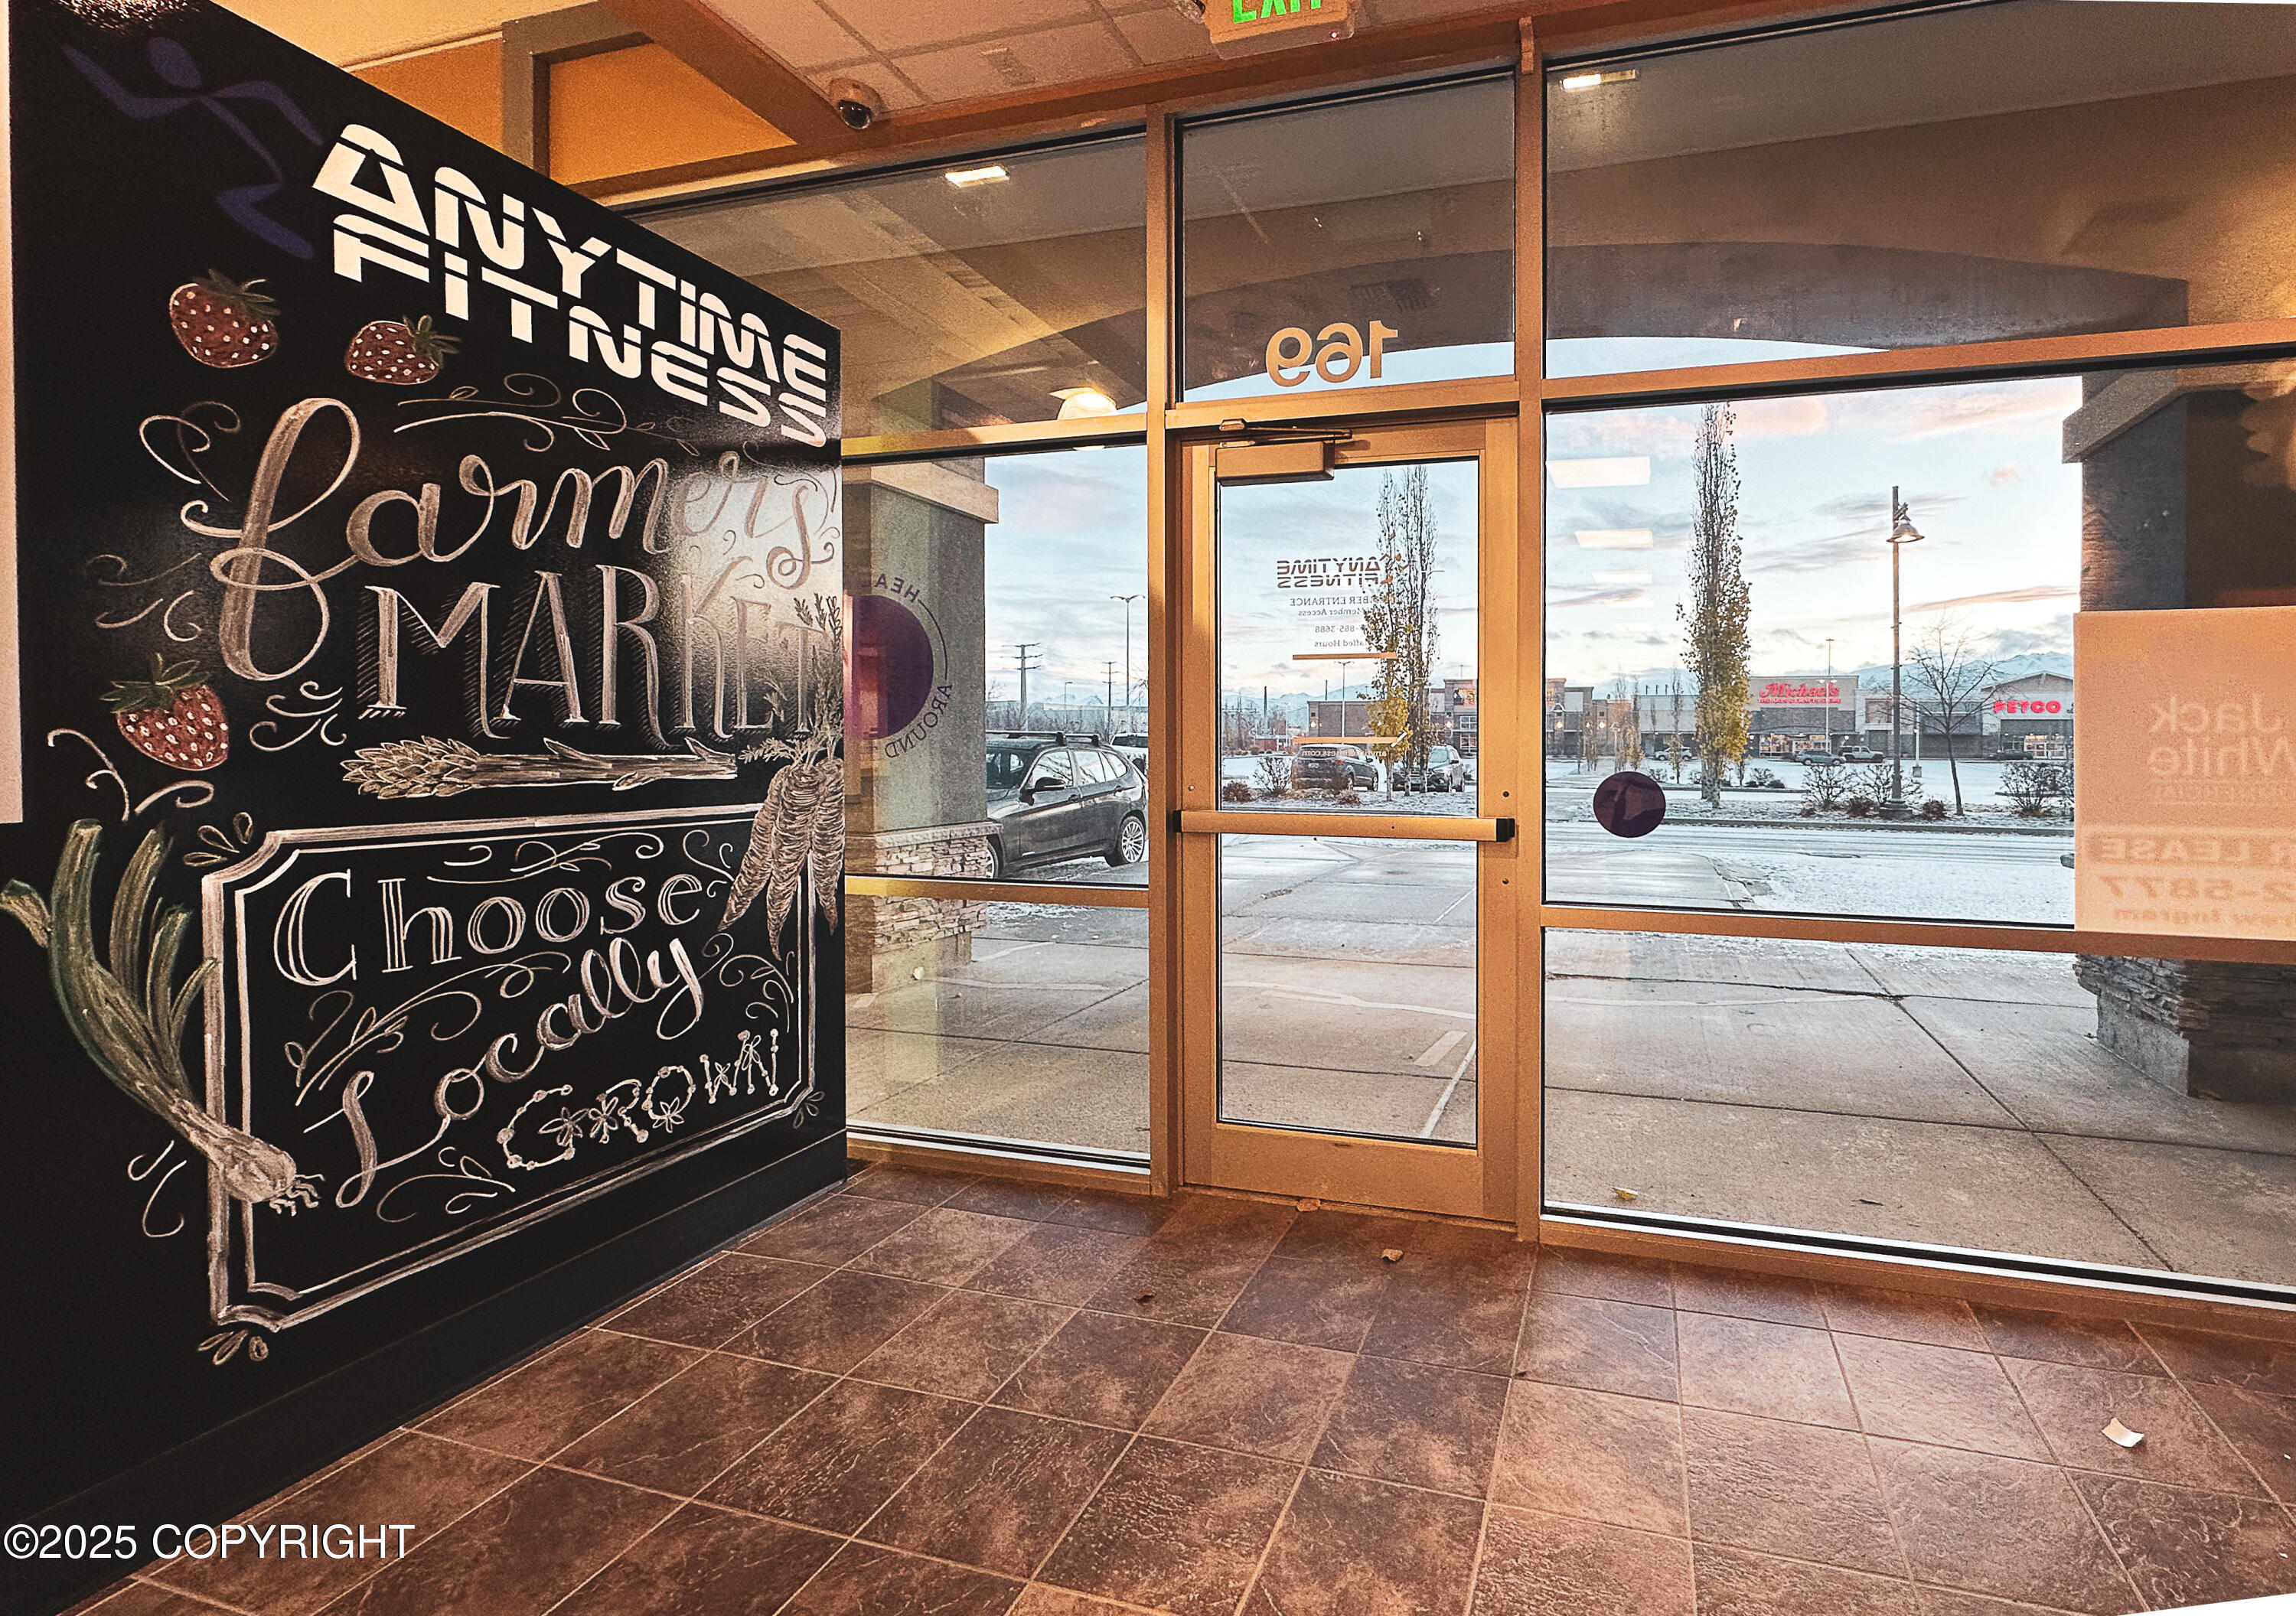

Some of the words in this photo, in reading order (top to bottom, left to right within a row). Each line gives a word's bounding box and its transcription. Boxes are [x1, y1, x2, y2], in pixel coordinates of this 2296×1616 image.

[312, 123, 827, 402] ANYTIME
[333, 213, 827, 448] FITNESS
[357, 565, 829, 750] MARKET
[1759, 683, 1840, 698] Michaels
[1993, 700, 2062, 715] PETCO
[273, 869, 703, 986] Choose
[304, 937, 706, 1207] Locally
[496, 1029, 779, 1171] GROWN
